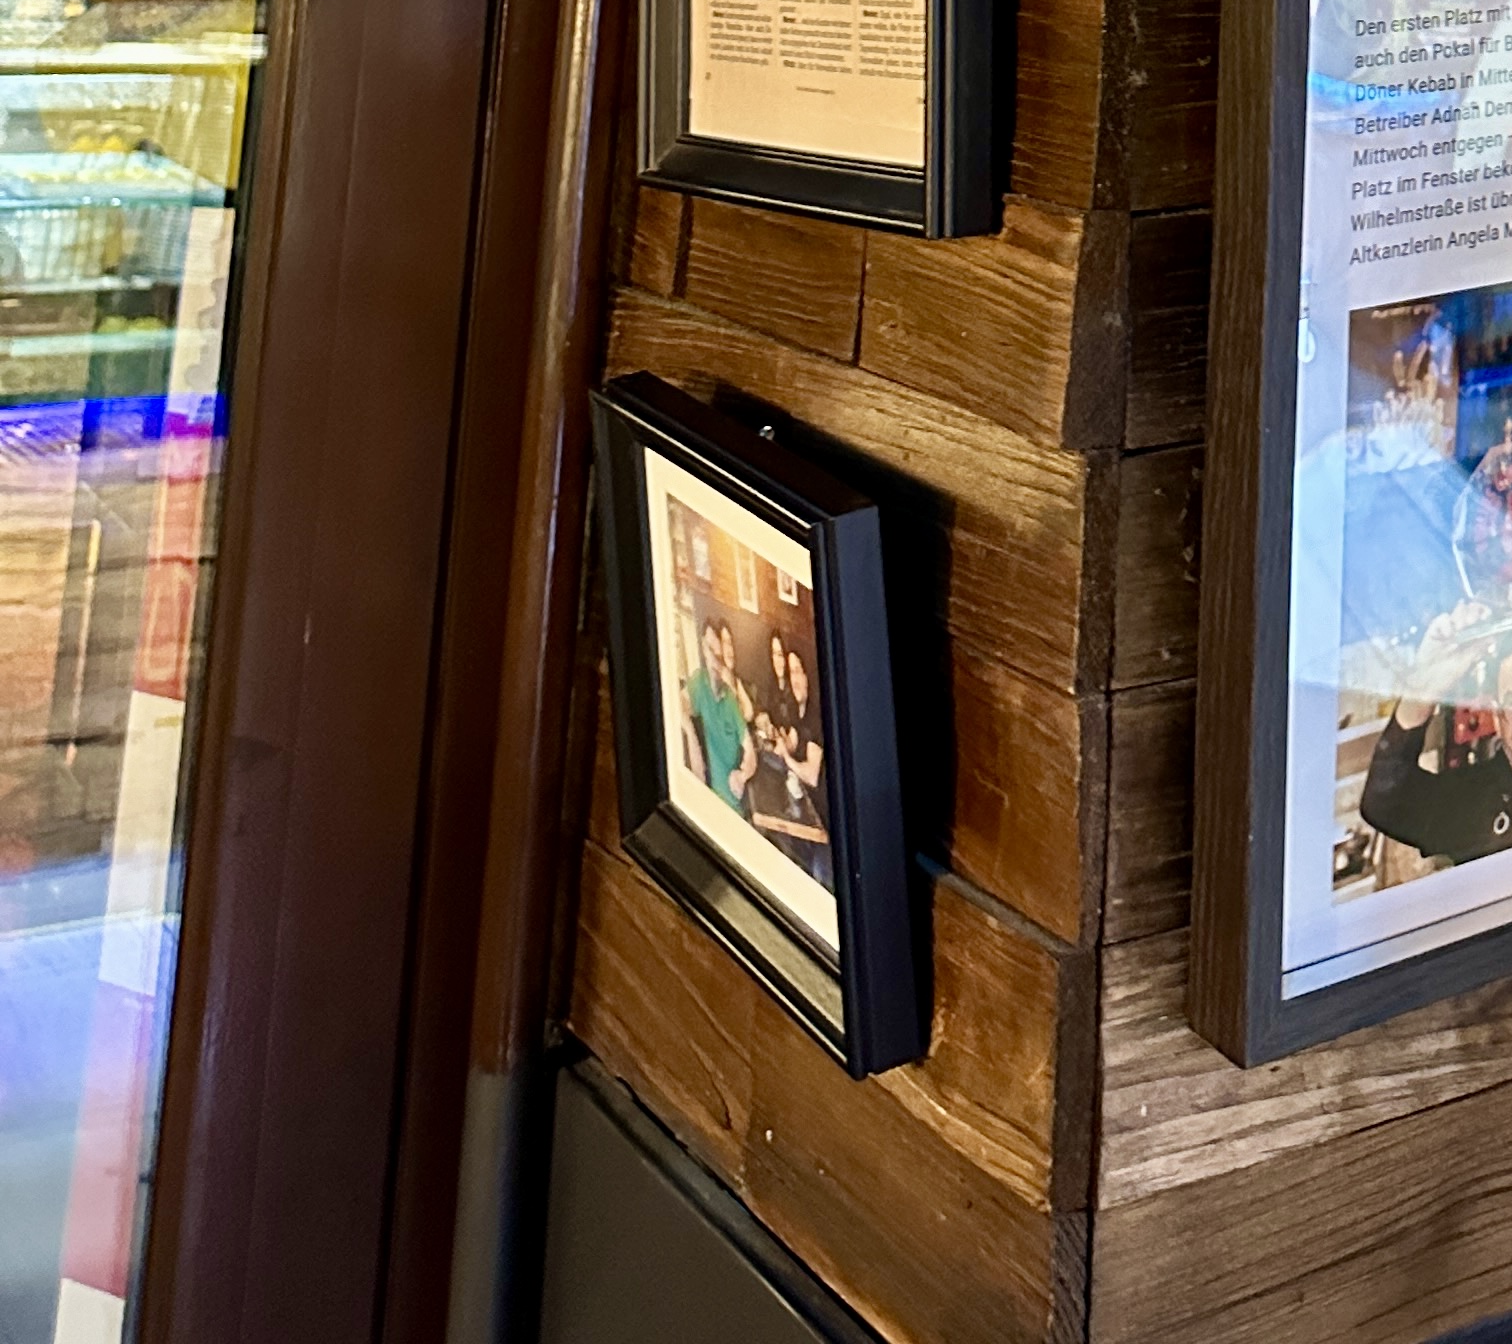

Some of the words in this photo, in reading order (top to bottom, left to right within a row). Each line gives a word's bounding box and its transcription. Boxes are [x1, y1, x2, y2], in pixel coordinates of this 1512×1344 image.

[1355, 19, 1386, 37] Den
[1390, 14, 1440, 33] ersten
[1444, 8, 1483, 27] Platz
[1486, 4, 1510, 23] mit
[1354, 48, 1395, 69] auch
[1398, 46, 1428, 64] den
[1432, 39, 1475, 60] Pokal
[1478, 36, 1500, 54] für
[1354, 83, 1404, 103] Döner
[1408, 73, 1456, 95] Kebab
[1460, 72, 1474, 89] in
[1355, 111, 1428, 135] Betreiber
[1430, 101, 1480, 125] Adnan
[1353, 140, 1428, 167] Mittwoch
[1431, 133, 1503, 158] entgegen
[1351, 180, 1393, 200] Platz
[1396, 176, 1417, 193] im
[1421, 168, 1479, 189] Fenster
[1351, 198, 1464, 232] Wilhelmstraße
[1467, 195, 1487, 213] ist
[1349, 234, 1443, 266] Altkanzlerin
[1446, 224, 1500, 249] Angela
